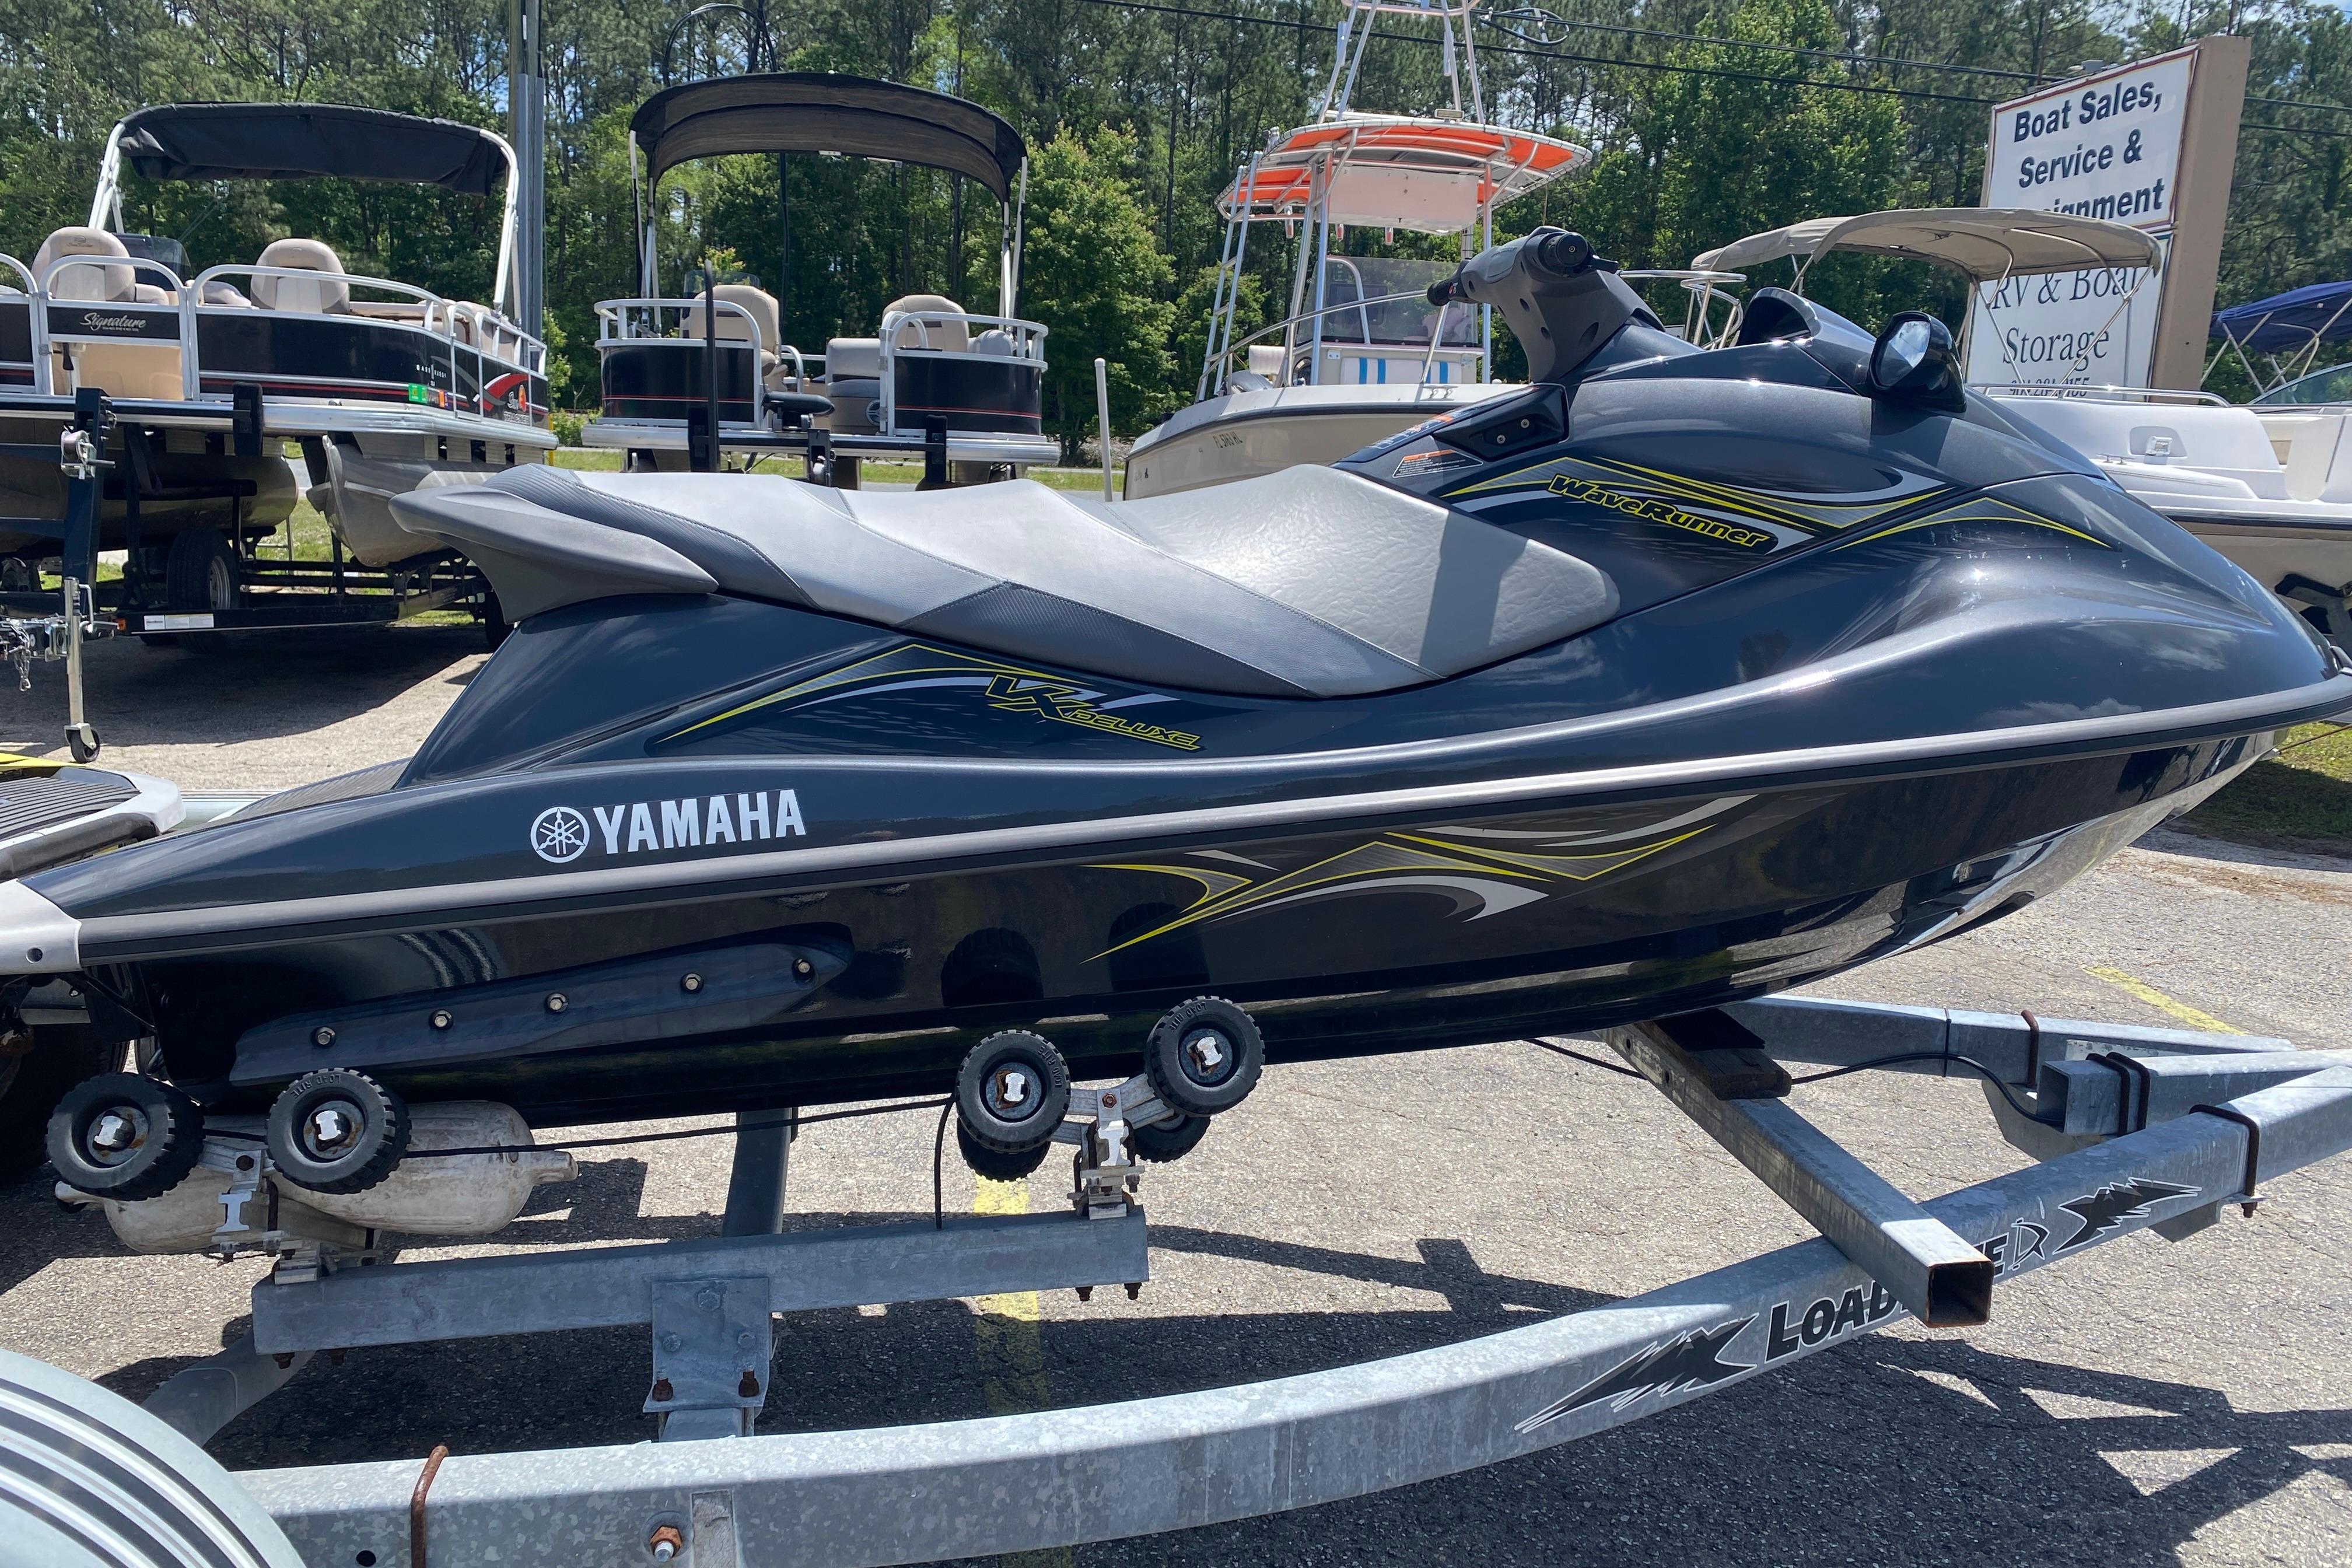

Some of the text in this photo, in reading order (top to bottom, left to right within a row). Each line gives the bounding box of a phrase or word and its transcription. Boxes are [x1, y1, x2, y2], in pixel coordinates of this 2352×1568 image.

[2014, 81, 2162, 142] Boat Sales,
[2019, 128, 2143, 188] Service &
[1992, 275, 2031, 310] RV
[2038, 272, 2062, 304] &
[79, 312, 146, 331] Signature
[2003, 327, 2109, 372] Storage
[1547, 474, 1772, 548] WaveRunner
[1069, 708, 1203, 749] DELUXE
[593, 789, 807, 855] YAMAHA
[1168, 1002, 1207, 1031] LOAD RITE
[290, 1073, 341, 1098] LOAD RITE
[1038, 1045, 1063, 1088] LOAD RITE
[1765, 1280, 1899, 1364] LOAD
